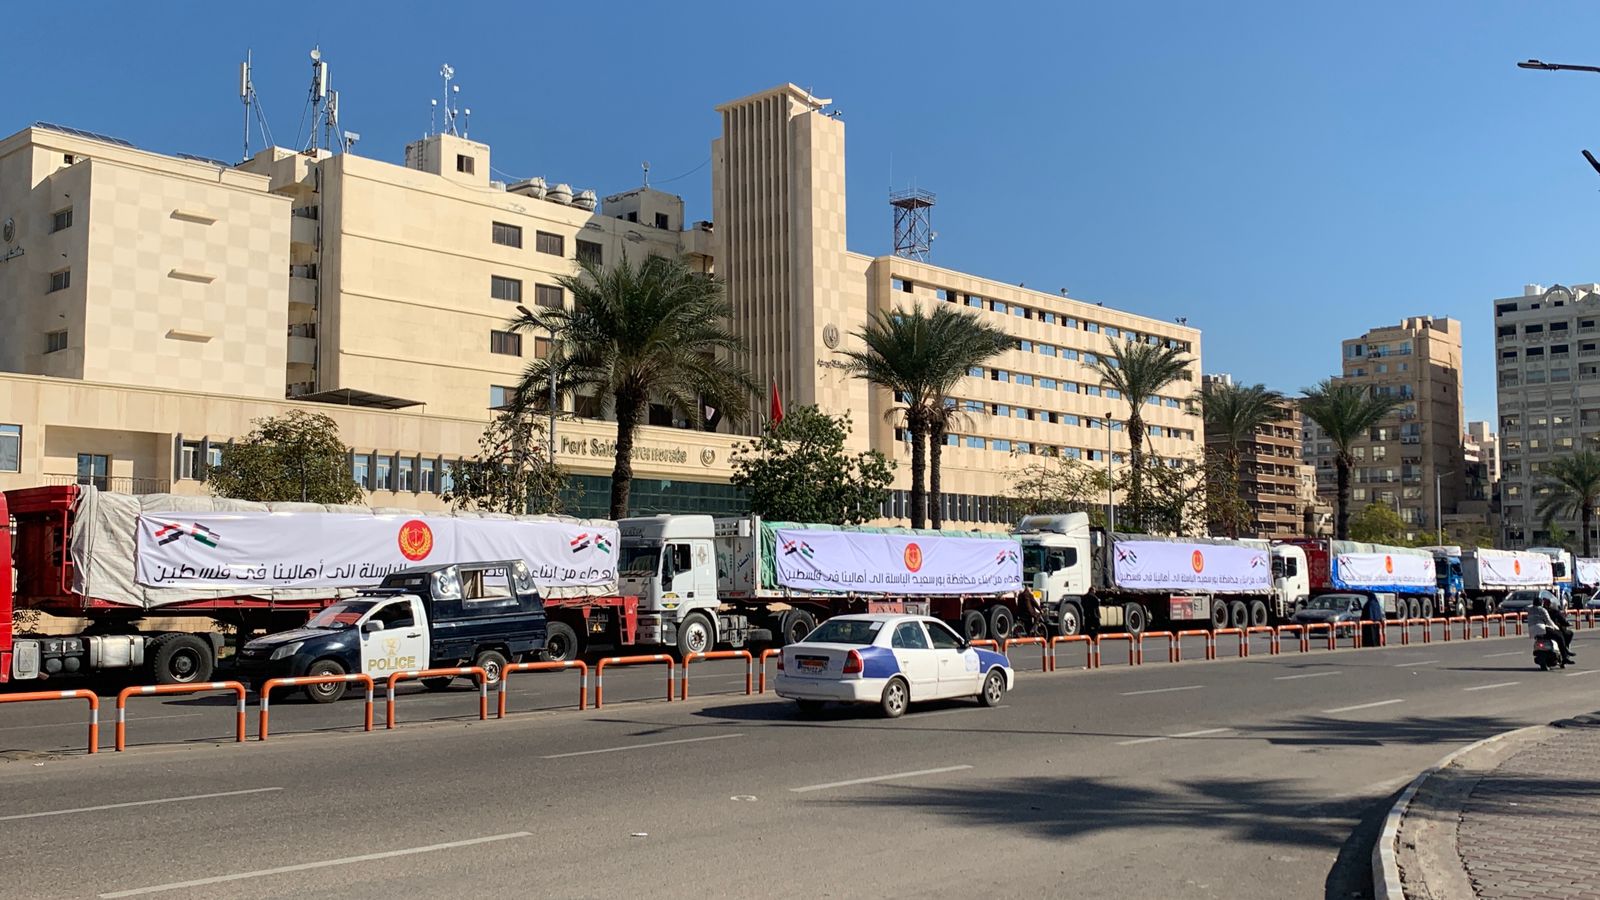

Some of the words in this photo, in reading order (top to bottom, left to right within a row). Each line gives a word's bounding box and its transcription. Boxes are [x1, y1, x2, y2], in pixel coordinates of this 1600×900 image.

[561, 436, 587, 456] Port
[590, 438, 618, 458] Said
[630, 445, 687, 464] overnorate
[154, 563, 231, 583] فلسطين
[272, 559, 324, 584] أهالينا
[561, 568, 577, 581] من
[784, 569, 822, 582] فلسطين
[367, 655, 416, 671] POLICE
